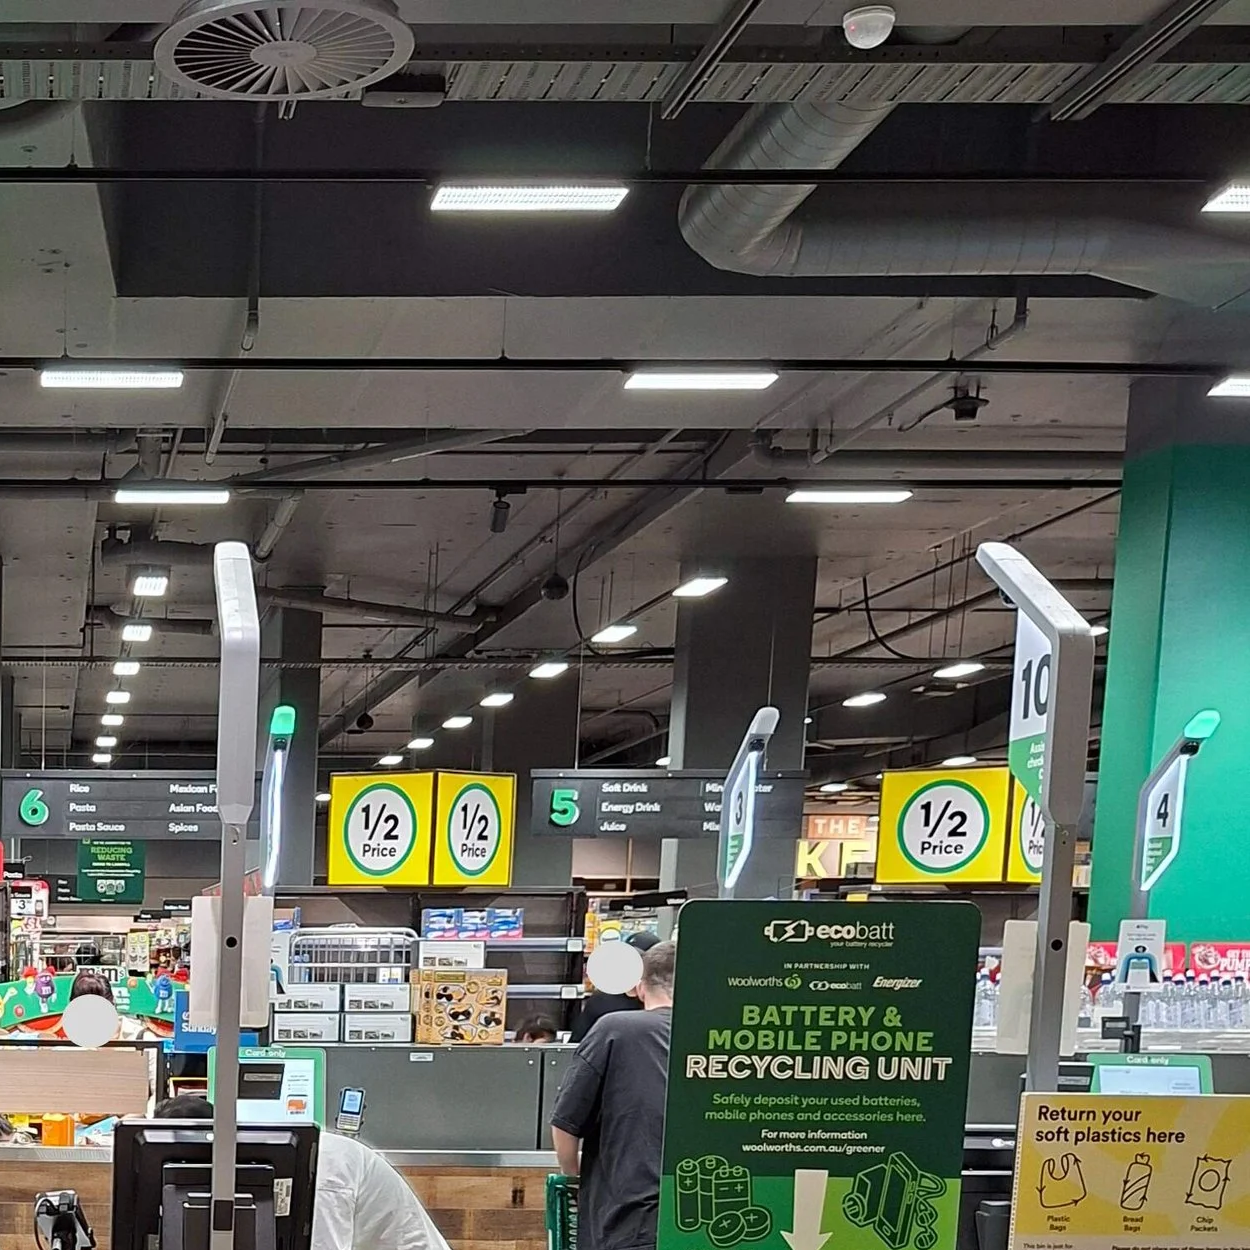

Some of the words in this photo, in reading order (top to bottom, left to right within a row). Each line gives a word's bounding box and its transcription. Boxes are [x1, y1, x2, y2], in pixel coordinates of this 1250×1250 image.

[1022, 654, 1050, 719] 10
[69, 784, 90, 794] Rice
[170, 784, 208, 793] Mexican
[602, 783, 621, 793] Soft
[622, 783, 648, 793] Drink
[20, 789, 49, 826] 6
[69, 803, 96, 813] Pasta
[169, 803, 195, 812] Asian
[550, 789, 580, 826] 5
[601, 802, 633, 814] Energy
[634, 802, 661, 812] Drink
[1157, 793, 1169, 827] 4
[361, 803, 400, 841] 1/2
[461, 803, 489, 841] 1/2
[814, 818, 860, 834] THE
[921, 800, 967, 837] 1/2
[69, 822, 95, 832] Pasta
[96, 822, 126, 832] Sauce
[168, 823, 198, 834] Spices
[600, 822, 627, 832] Juice
[362, 843, 397, 858] Price
[461, 843, 487, 858] Price
[920, 841, 964, 856] Price
[1028, 840, 1043, 855] Pric
[816, 921, 895, 940] ecobatt
[849, 963, 870, 971] WITH
[872, 976, 923, 991] Energizer
[742, 1005, 877, 1027] BATTERY
[882, 1006, 903, 1028] &
[708, 1029, 822, 1051] MOBILE
[830, 1031, 935, 1052] PHONE
[245, 1049, 265, 1057] Card
[268, 1050, 286, 1058] only
[1127, 1056, 1148, 1064] Card
[1151, 1056, 1169, 1066] only
[685, 1054, 870, 1081] RECYCLING
[877, 1056, 953, 1081] UNIT
[712, 1093, 751, 1108] Safely
[753, 1094, 799, 1108] deposit
[800, 1096, 829, 1109] your
[830, 1095, 860, 1106] used
[862, 1095, 921, 1108] batteries,
[705, 1110, 747, 1121] mobile
[749, 1110, 794, 1123] phones
[796, 1111, 821, 1121] and
[823, 1111, 894, 1122] accessories
[896, 1112, 926, 1123] here.
[1038, 1105, 1096, 1121] Return
[1102, 1109, 1141, 1125] your
[761, 1128, 778, 1139] For
[779, 1131, 806, 1140] more
[807, 1129, 867, 1140] information
[1035, 1127, 1070, 1142] soft
[1074, 1127, 1141, 1145] plastics
[1147, 1128, 1185, 1143] here
[742, 1142, 886, 1155] woolworths.com.au/greener
[1047, 1215, 1070, 1223] Plastic
[1196, 1216, 1213, 1225] Chip
[1050, 1224, 1066, 1232] Bags
[1124, 1224, 1140, 1232] Bags
